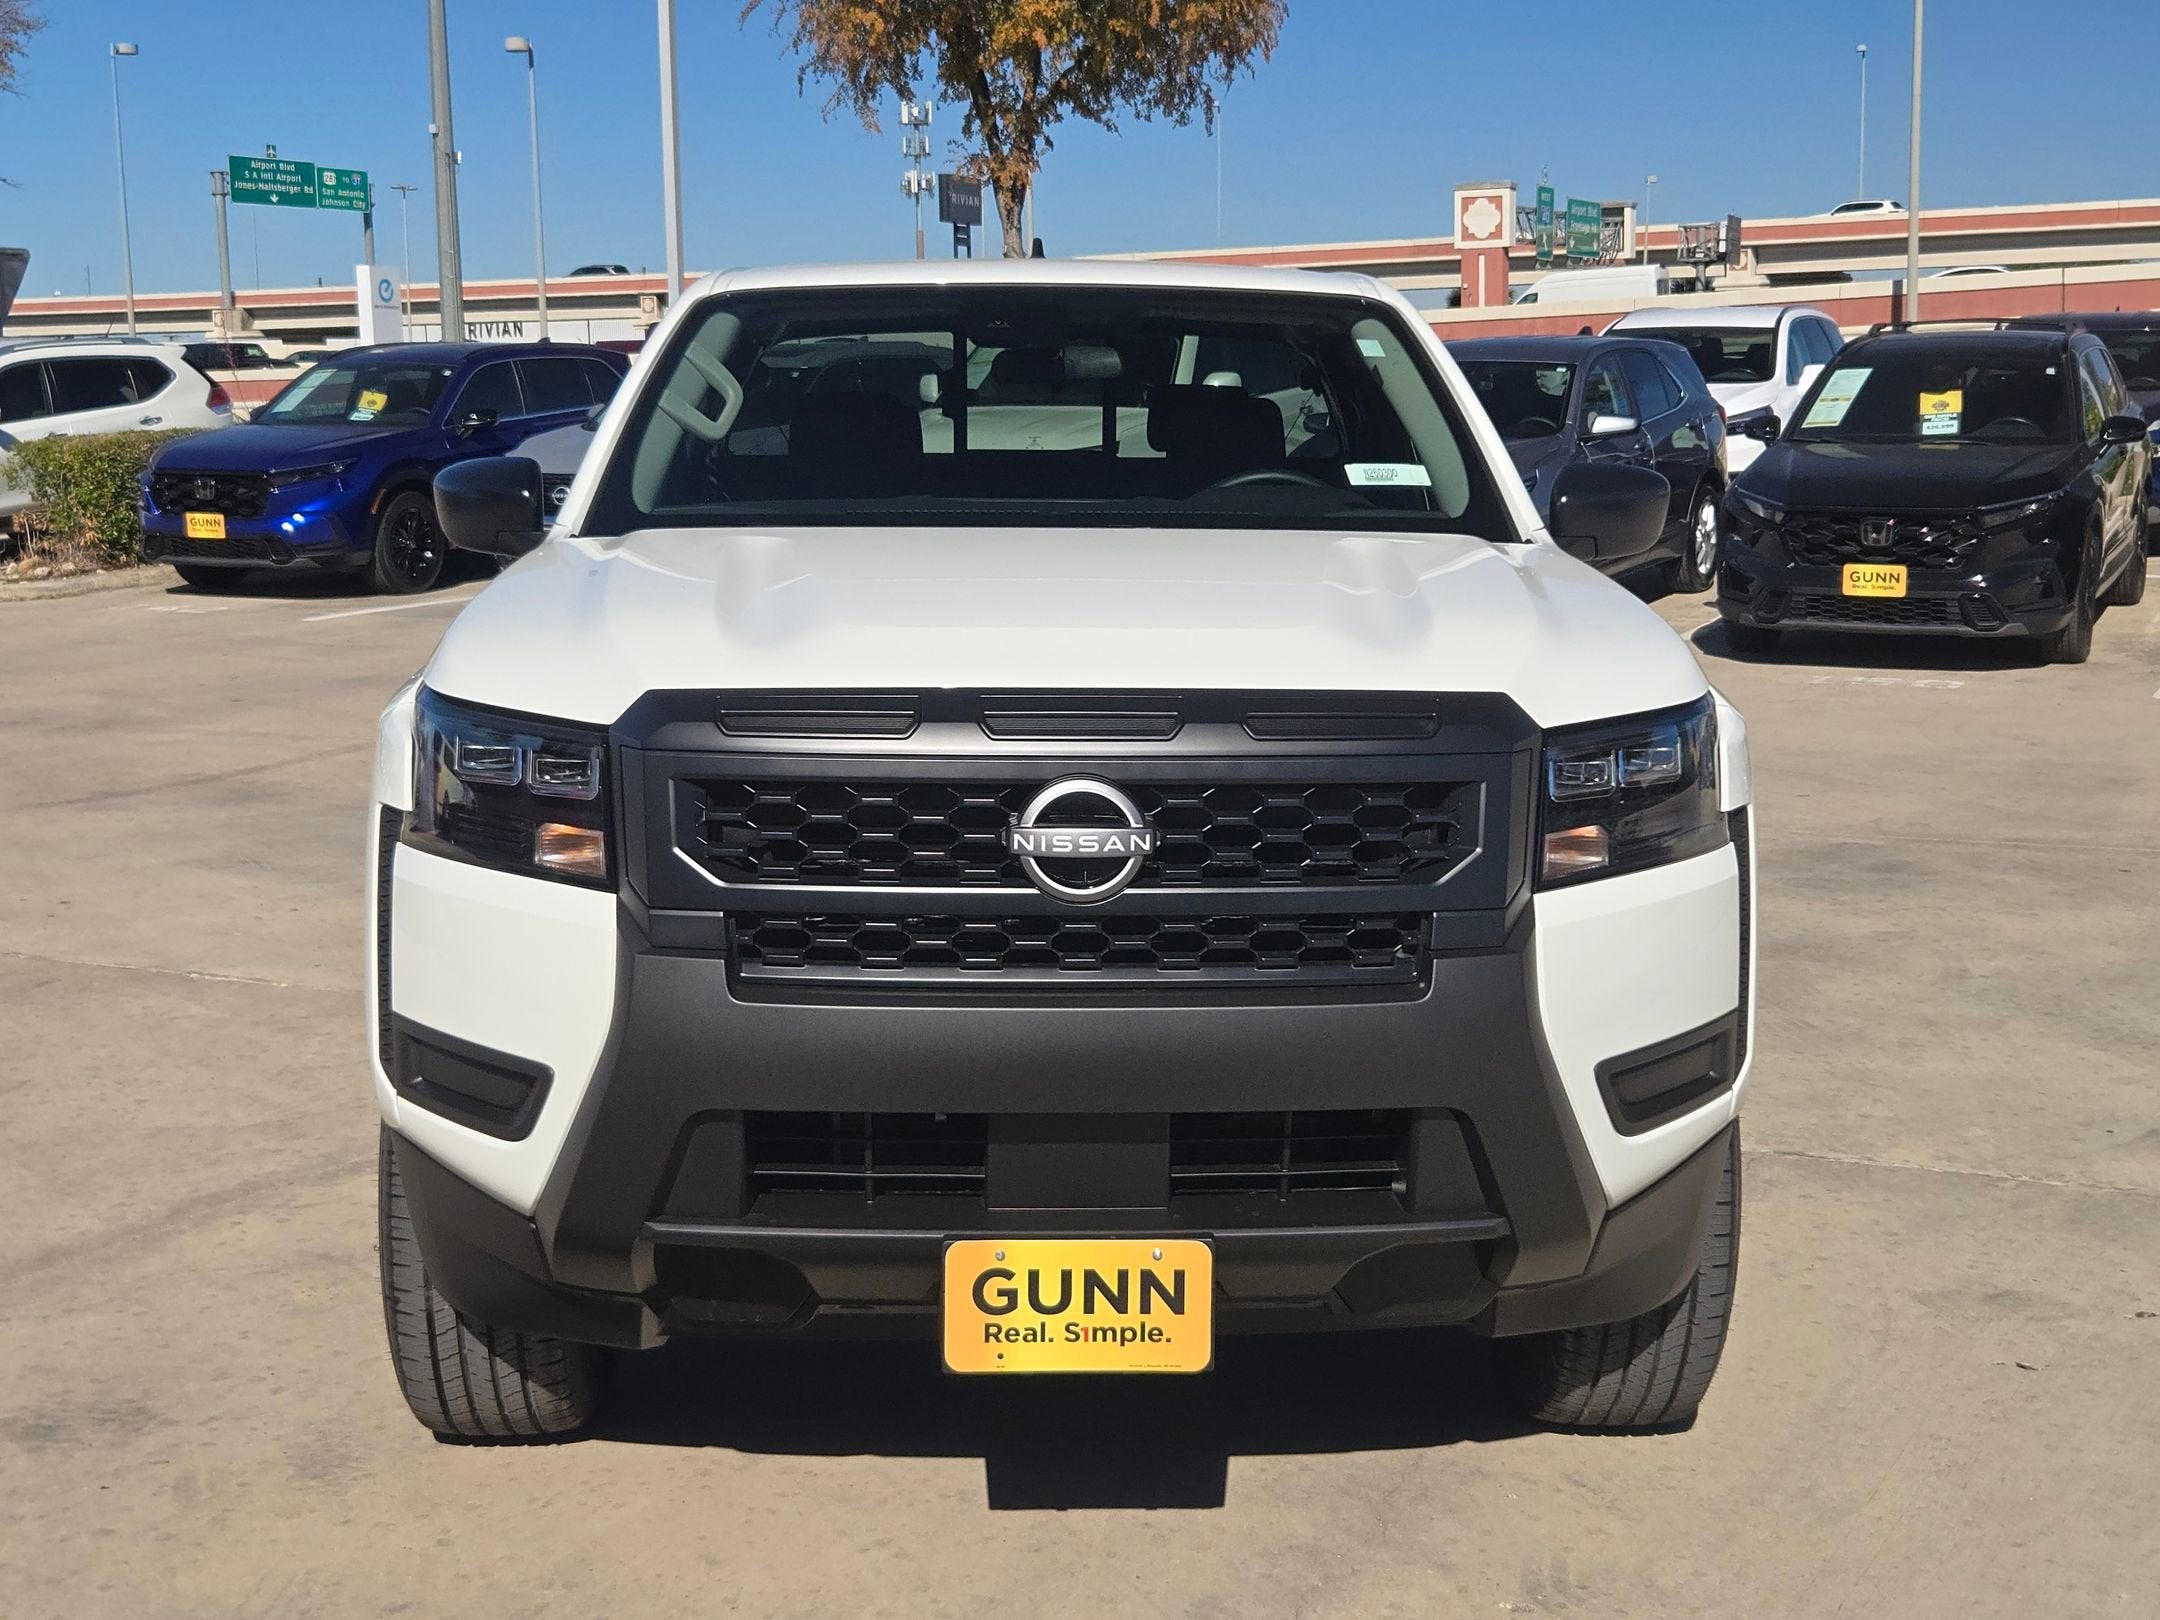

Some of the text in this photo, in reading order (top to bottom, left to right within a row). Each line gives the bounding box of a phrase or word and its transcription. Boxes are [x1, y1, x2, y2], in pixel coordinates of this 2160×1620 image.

[250, 161, 295, 172] Airport Blvd
[245, 171, 250, 179] S
[252, 171, 258, 179] A
[276, 173, 302, 183] Airport
[322, 188, 335, 196] San
[951, 193, 980, 207] RIVIAN
[467, 321, 524, 339] RIVIAN
[190, 517, 221, 527] GUNN
[1849, 571, 1901, 583] GUNN
[1013, 833, 1150, 852] NISSAN
[971, 1266, 1186, 1316] GUNN
[984, 1321, 1054, 1343] Real.
